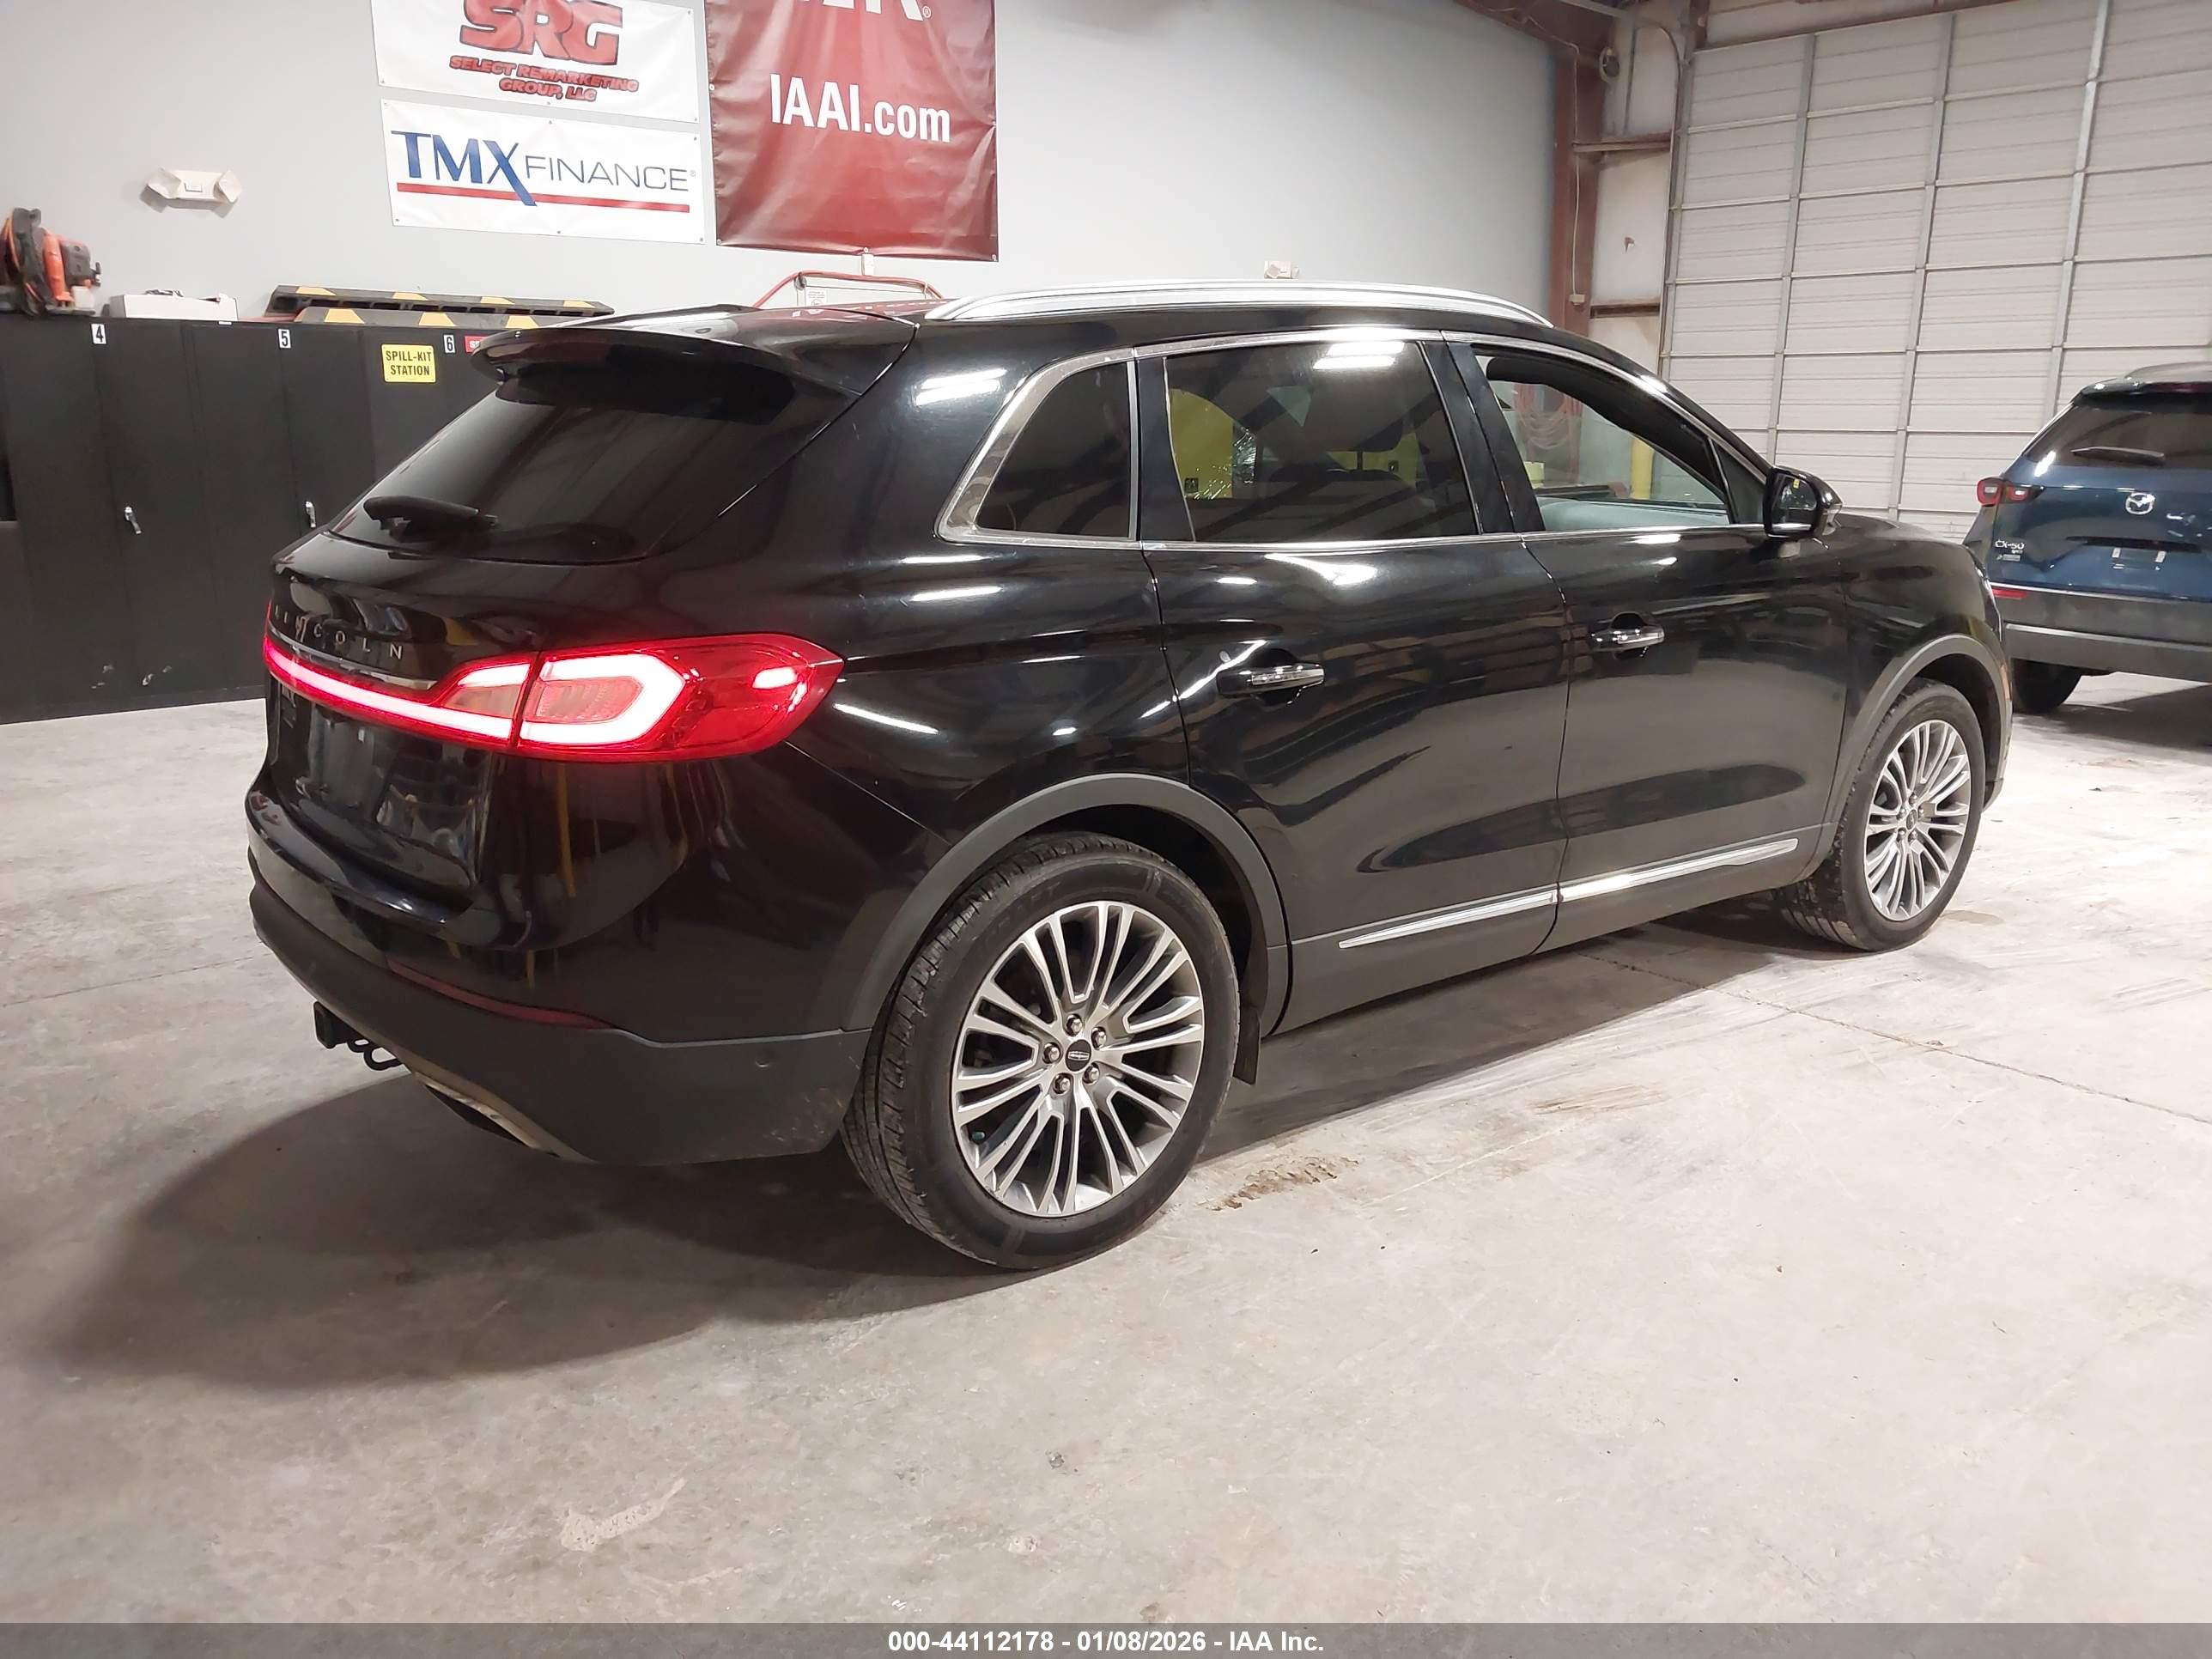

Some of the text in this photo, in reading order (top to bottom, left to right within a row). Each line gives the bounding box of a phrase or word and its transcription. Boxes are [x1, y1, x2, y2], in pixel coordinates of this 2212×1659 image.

[459, 0, 623, 65] SRG
[448, 55, 639, 92] SELECT REMARKETING
[499, 78, 598, 101] GROUP, LLC
[770, 73, 951, 143] IAAI.com
[391, 131, 689, 206] TMX FINANCE
[95, 325, 105, 343] 4
[281, 331, 289, 347] 5
[446, 336, 454, 351] 6
[386, 350, 432, 362] SPILL-KIT
[390, 365, 430, 375] STATION
[275, 605, 403, 659] LINCOLN
